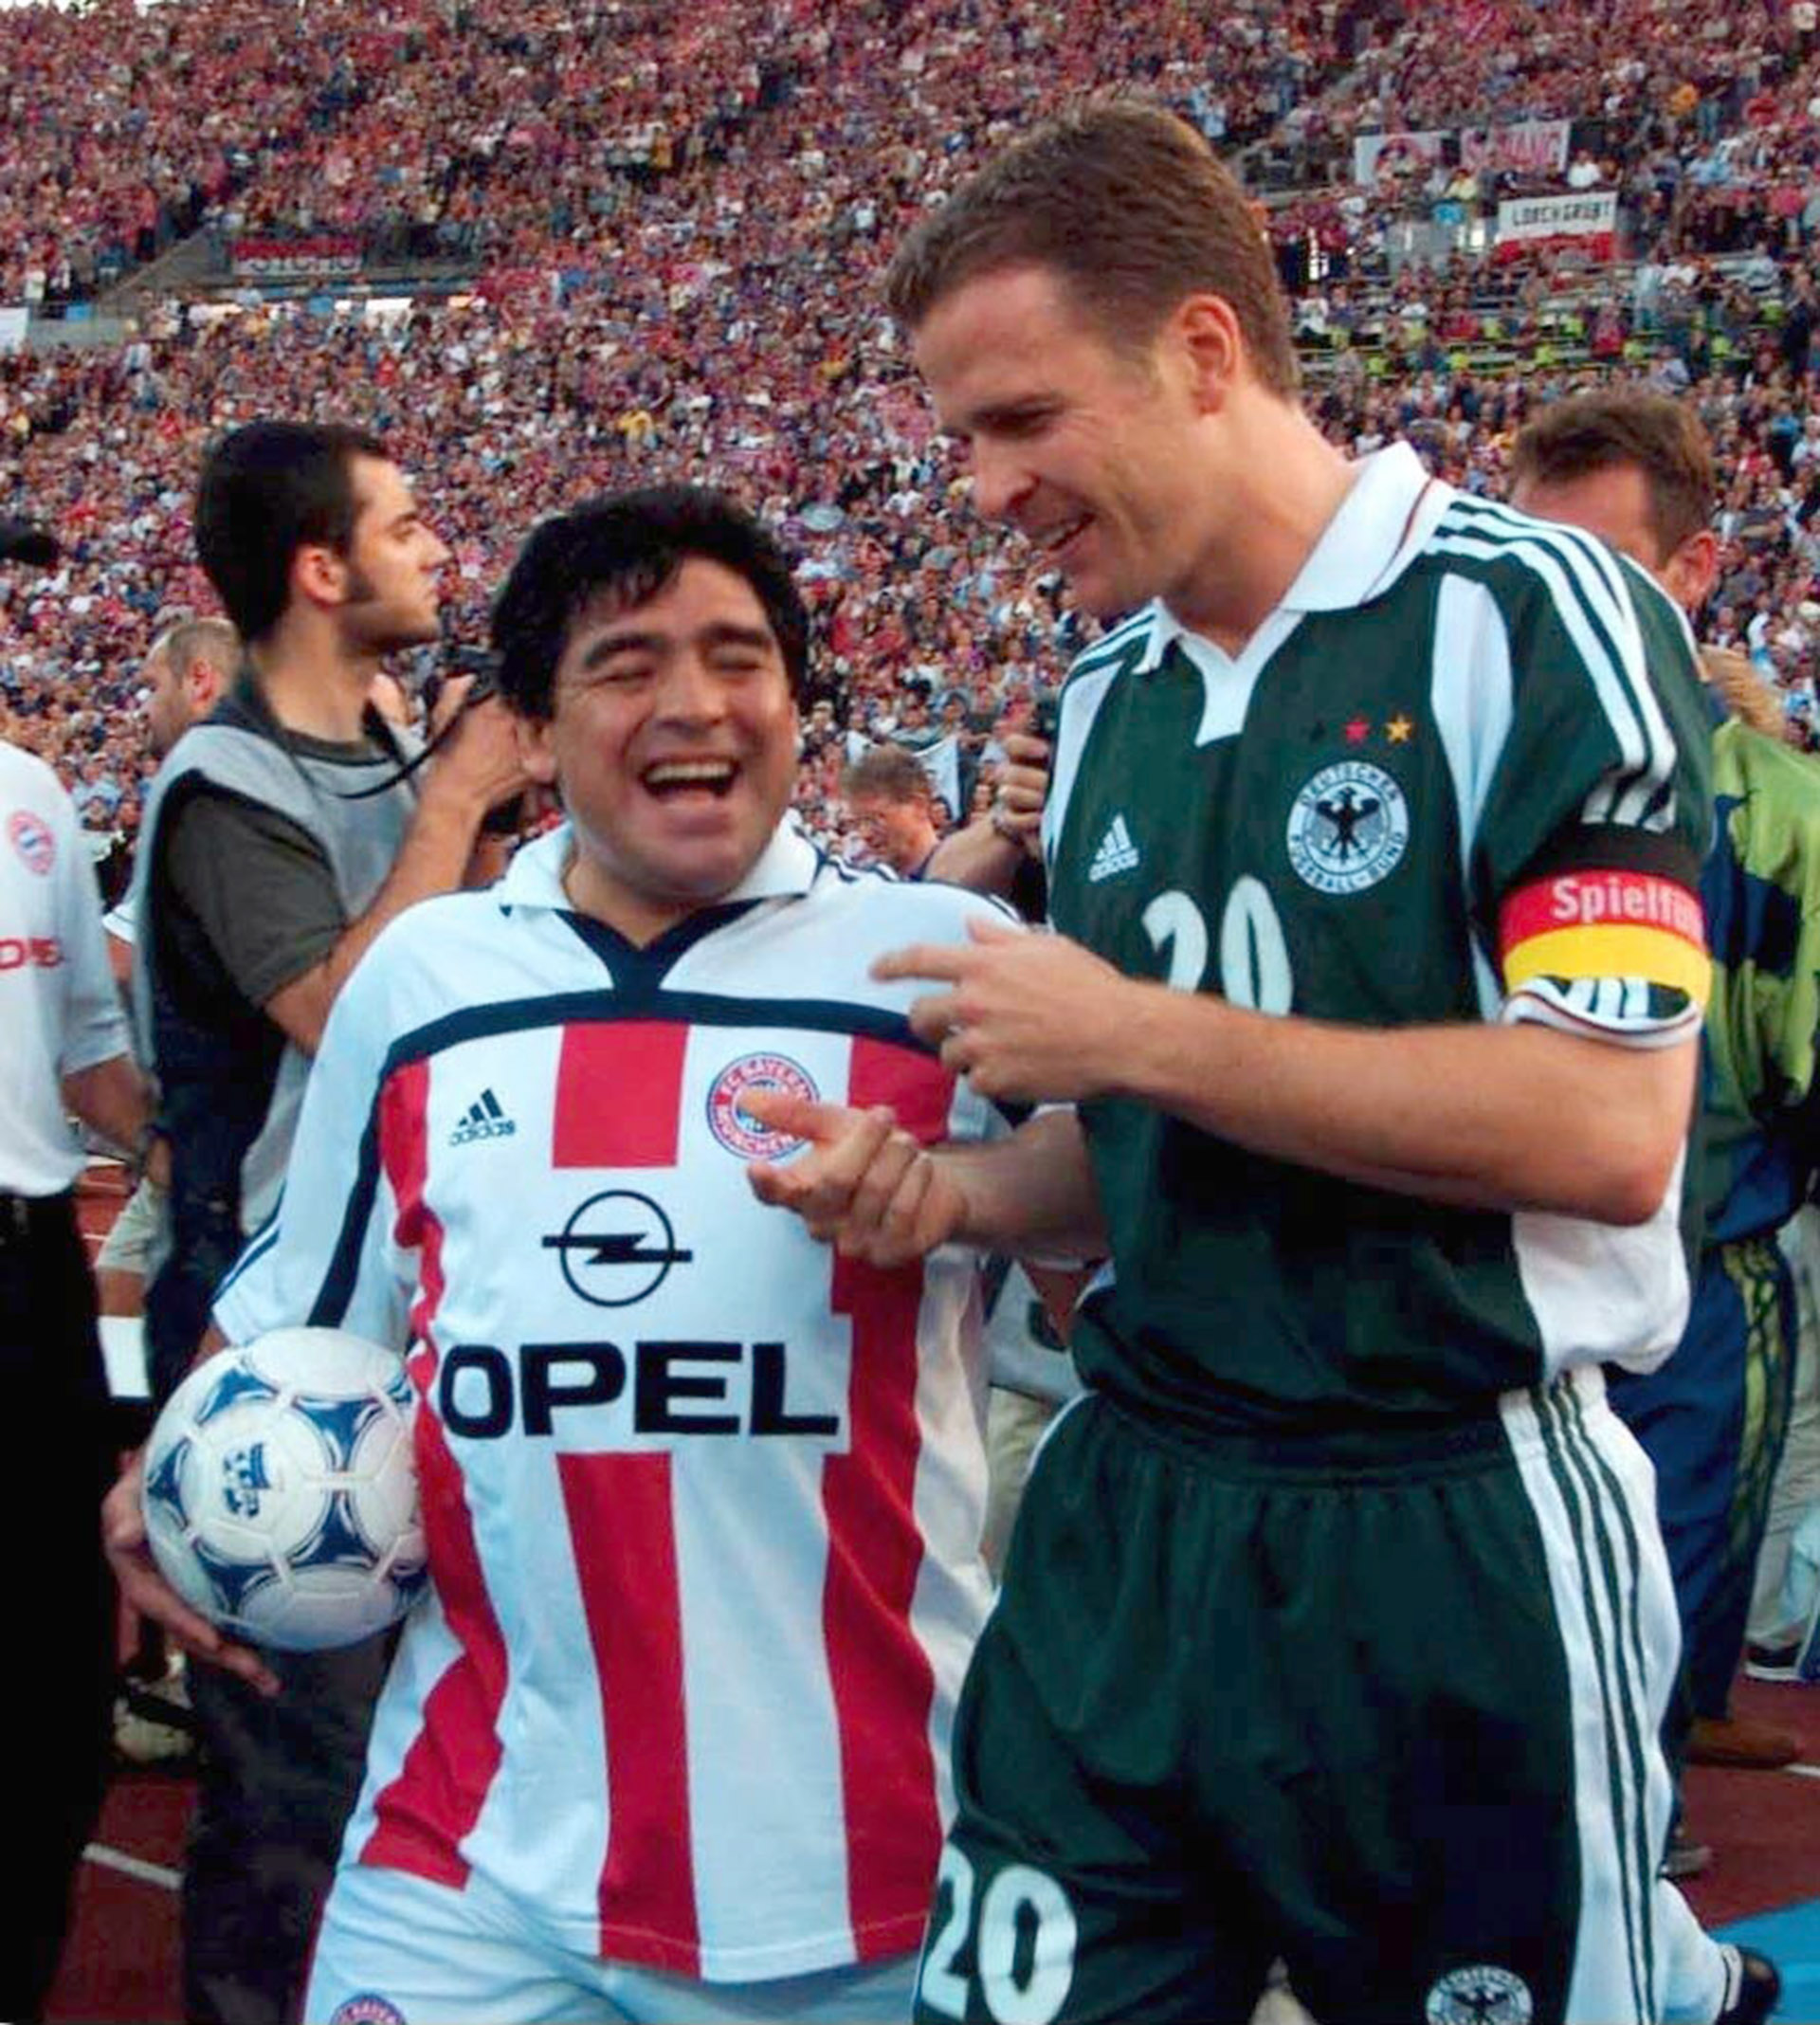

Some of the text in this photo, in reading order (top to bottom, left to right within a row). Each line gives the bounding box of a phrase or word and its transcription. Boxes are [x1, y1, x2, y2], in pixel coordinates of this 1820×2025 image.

[1141, 874, 1292, 1016] 20
[448, 1119, 516, 1147] adidas
[440, 1341, 840, 1439] OPEL
[920, 1842, 1078, 2025] 20
